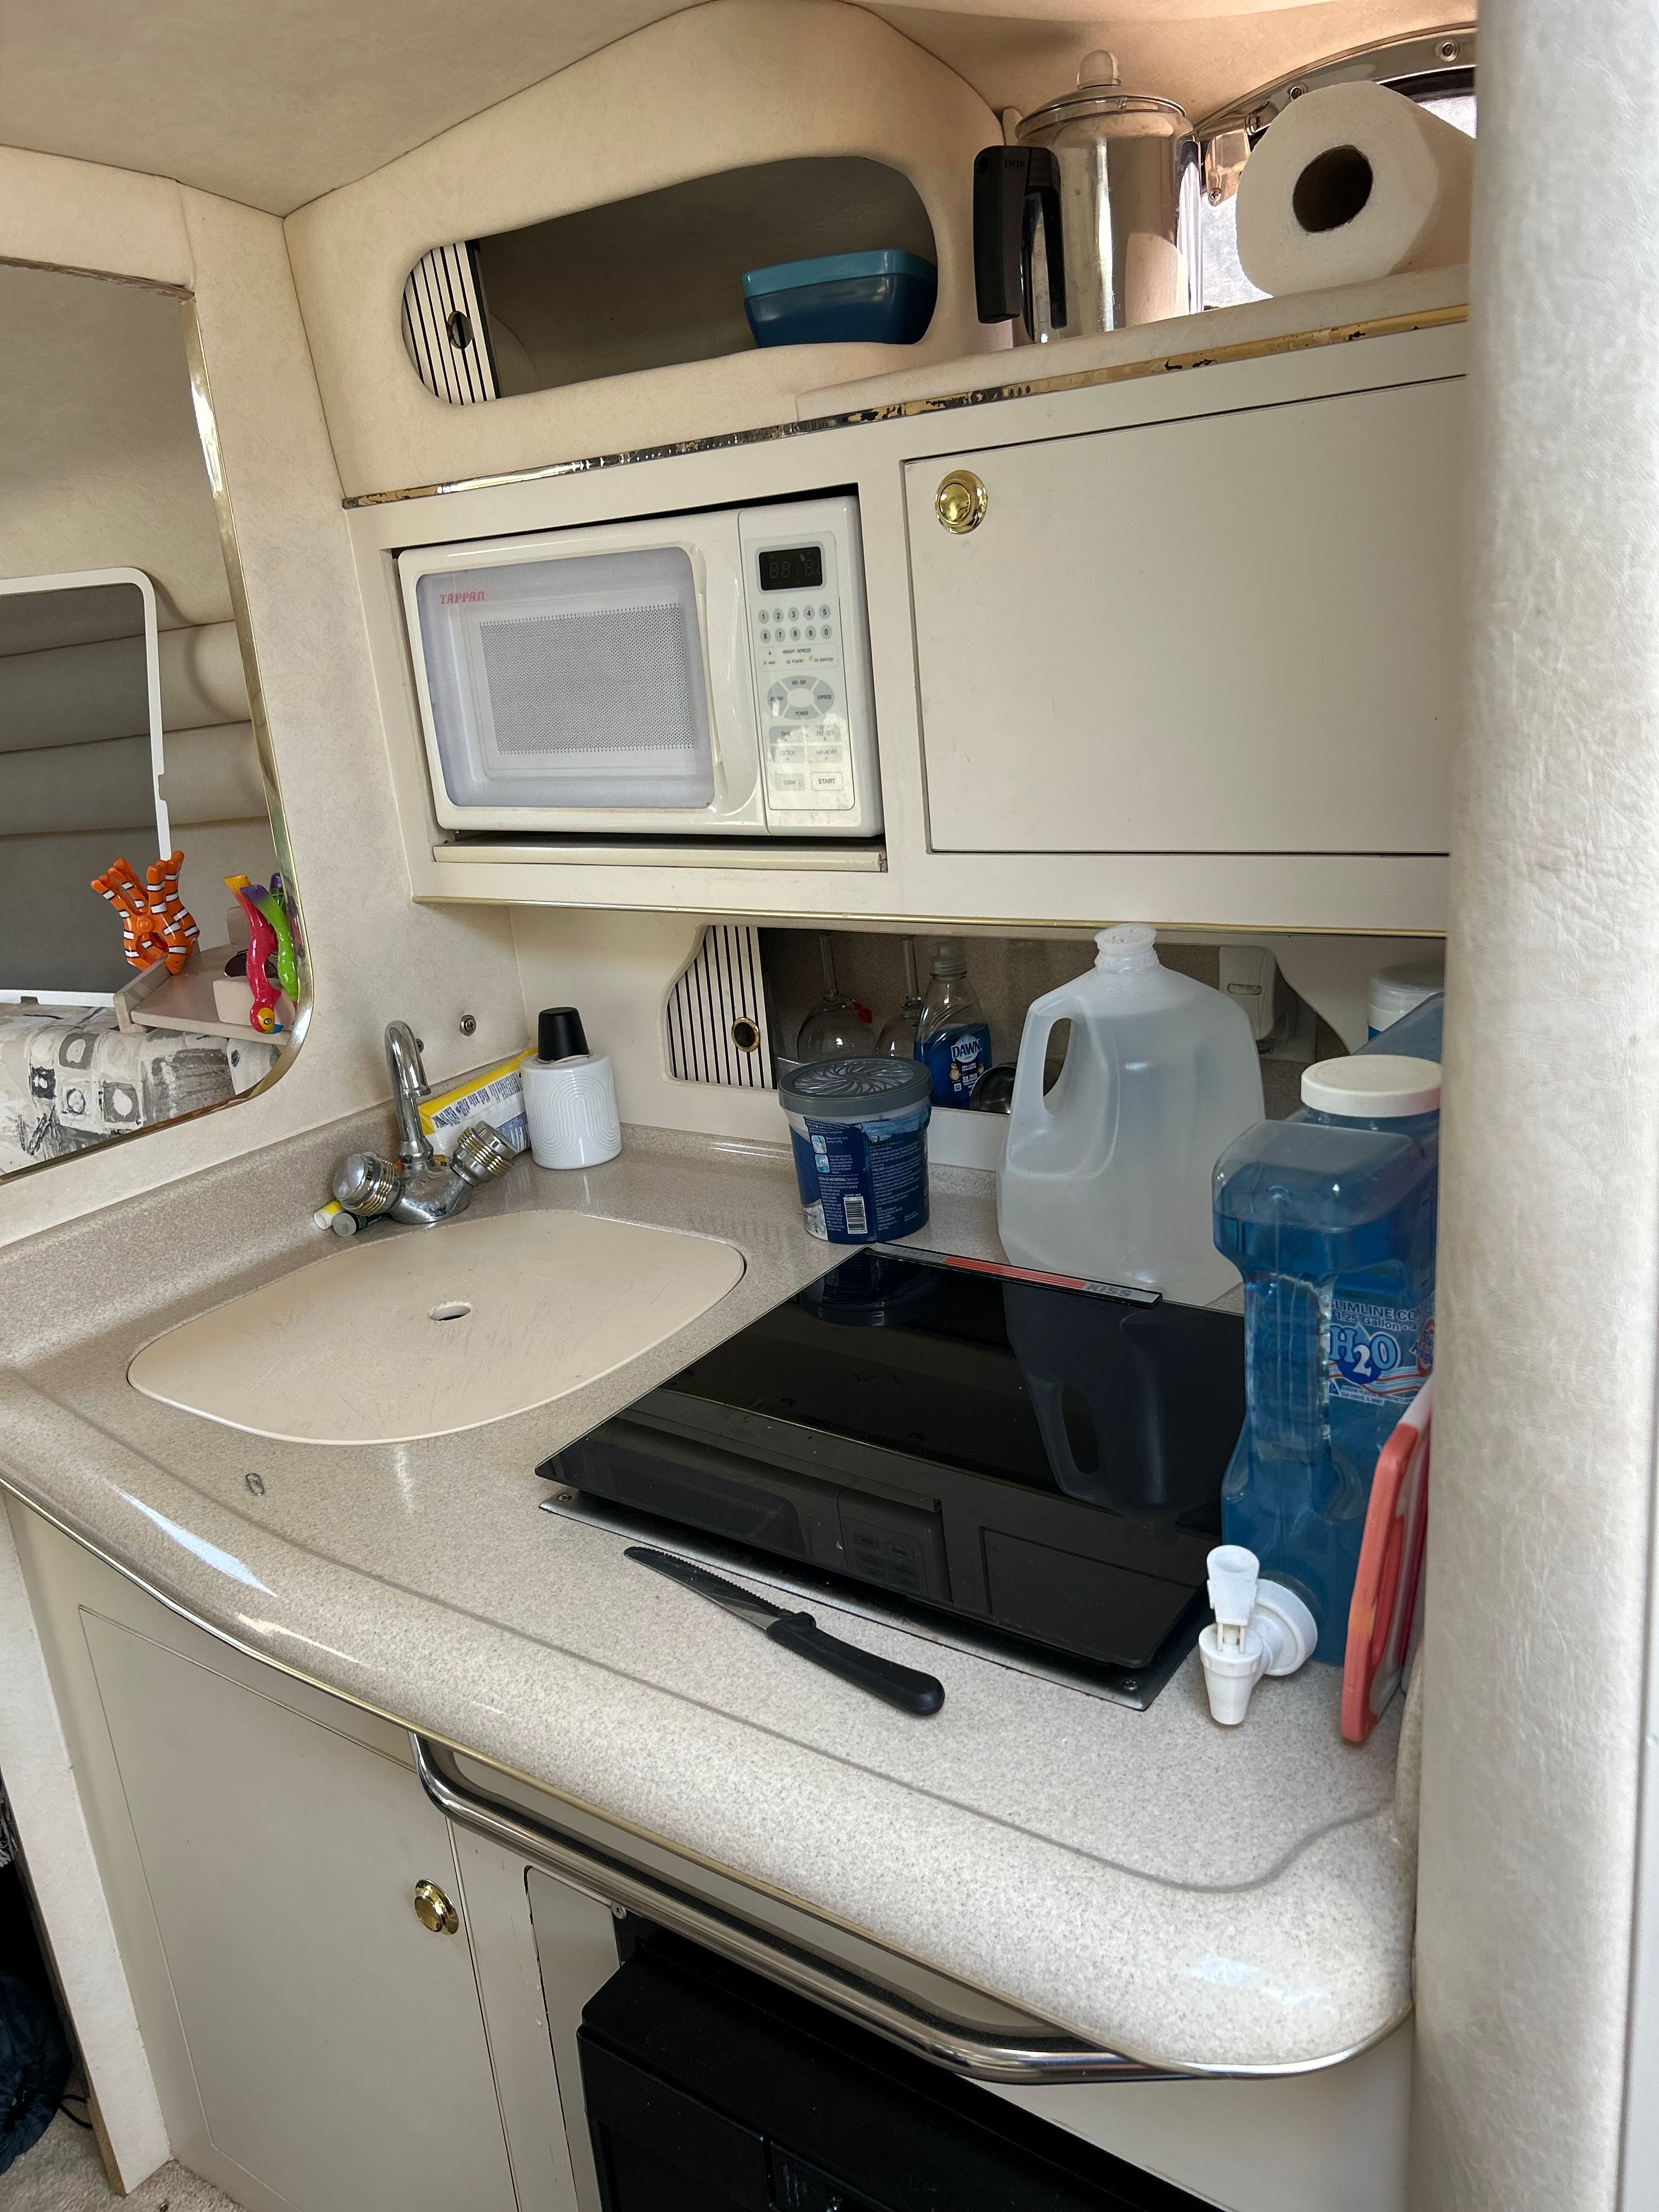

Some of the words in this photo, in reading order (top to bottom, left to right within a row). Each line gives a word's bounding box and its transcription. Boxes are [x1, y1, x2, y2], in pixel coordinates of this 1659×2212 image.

[439, 590, 486, 605] TAPPAN
[951, 1039, 983, 1060] DAWN
[1086, 1283, 1133, 1297] KISS
[1330, 1299, 1393, 1319] SLIMLINE
[1362, 1316, 1400, 1331] Gallon
[1329, 1325, 1398, 1378] H2O
